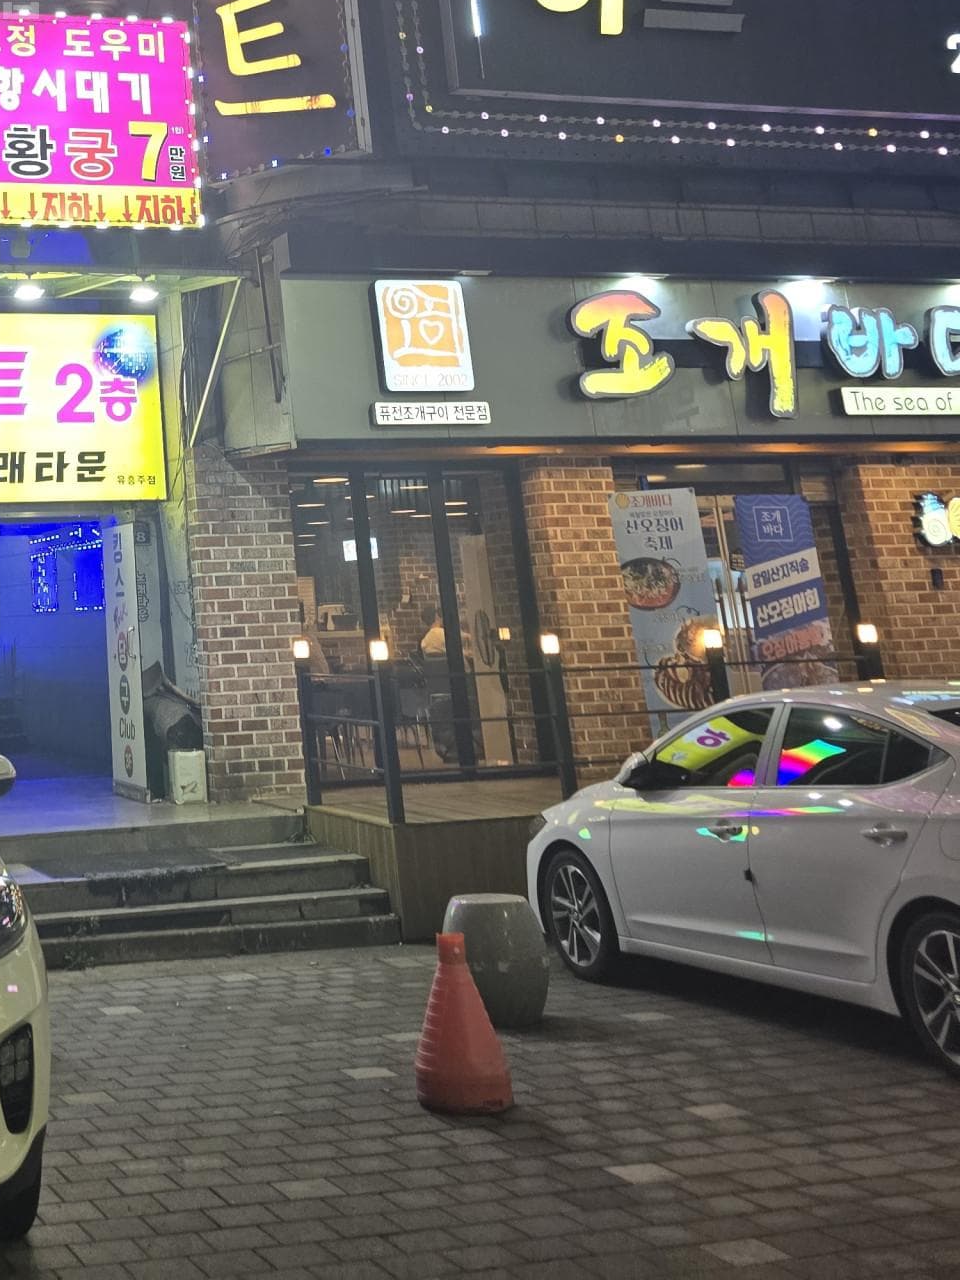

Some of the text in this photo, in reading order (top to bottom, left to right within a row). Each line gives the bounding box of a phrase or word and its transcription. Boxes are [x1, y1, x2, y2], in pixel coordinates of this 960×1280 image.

[63, 27, 165, 63] 도우미
[128, 120, 169, 182] 7
[42, 190, 92, 223] 지하
[135, 194, 186, 225] 지하
[54, 362, 138, 424] 2층
[850, 391, 953, 411] The sea of
[380, 405, 488, 421] 퓨전조개구이 전문점
[119, 716, 136, 740] Club
